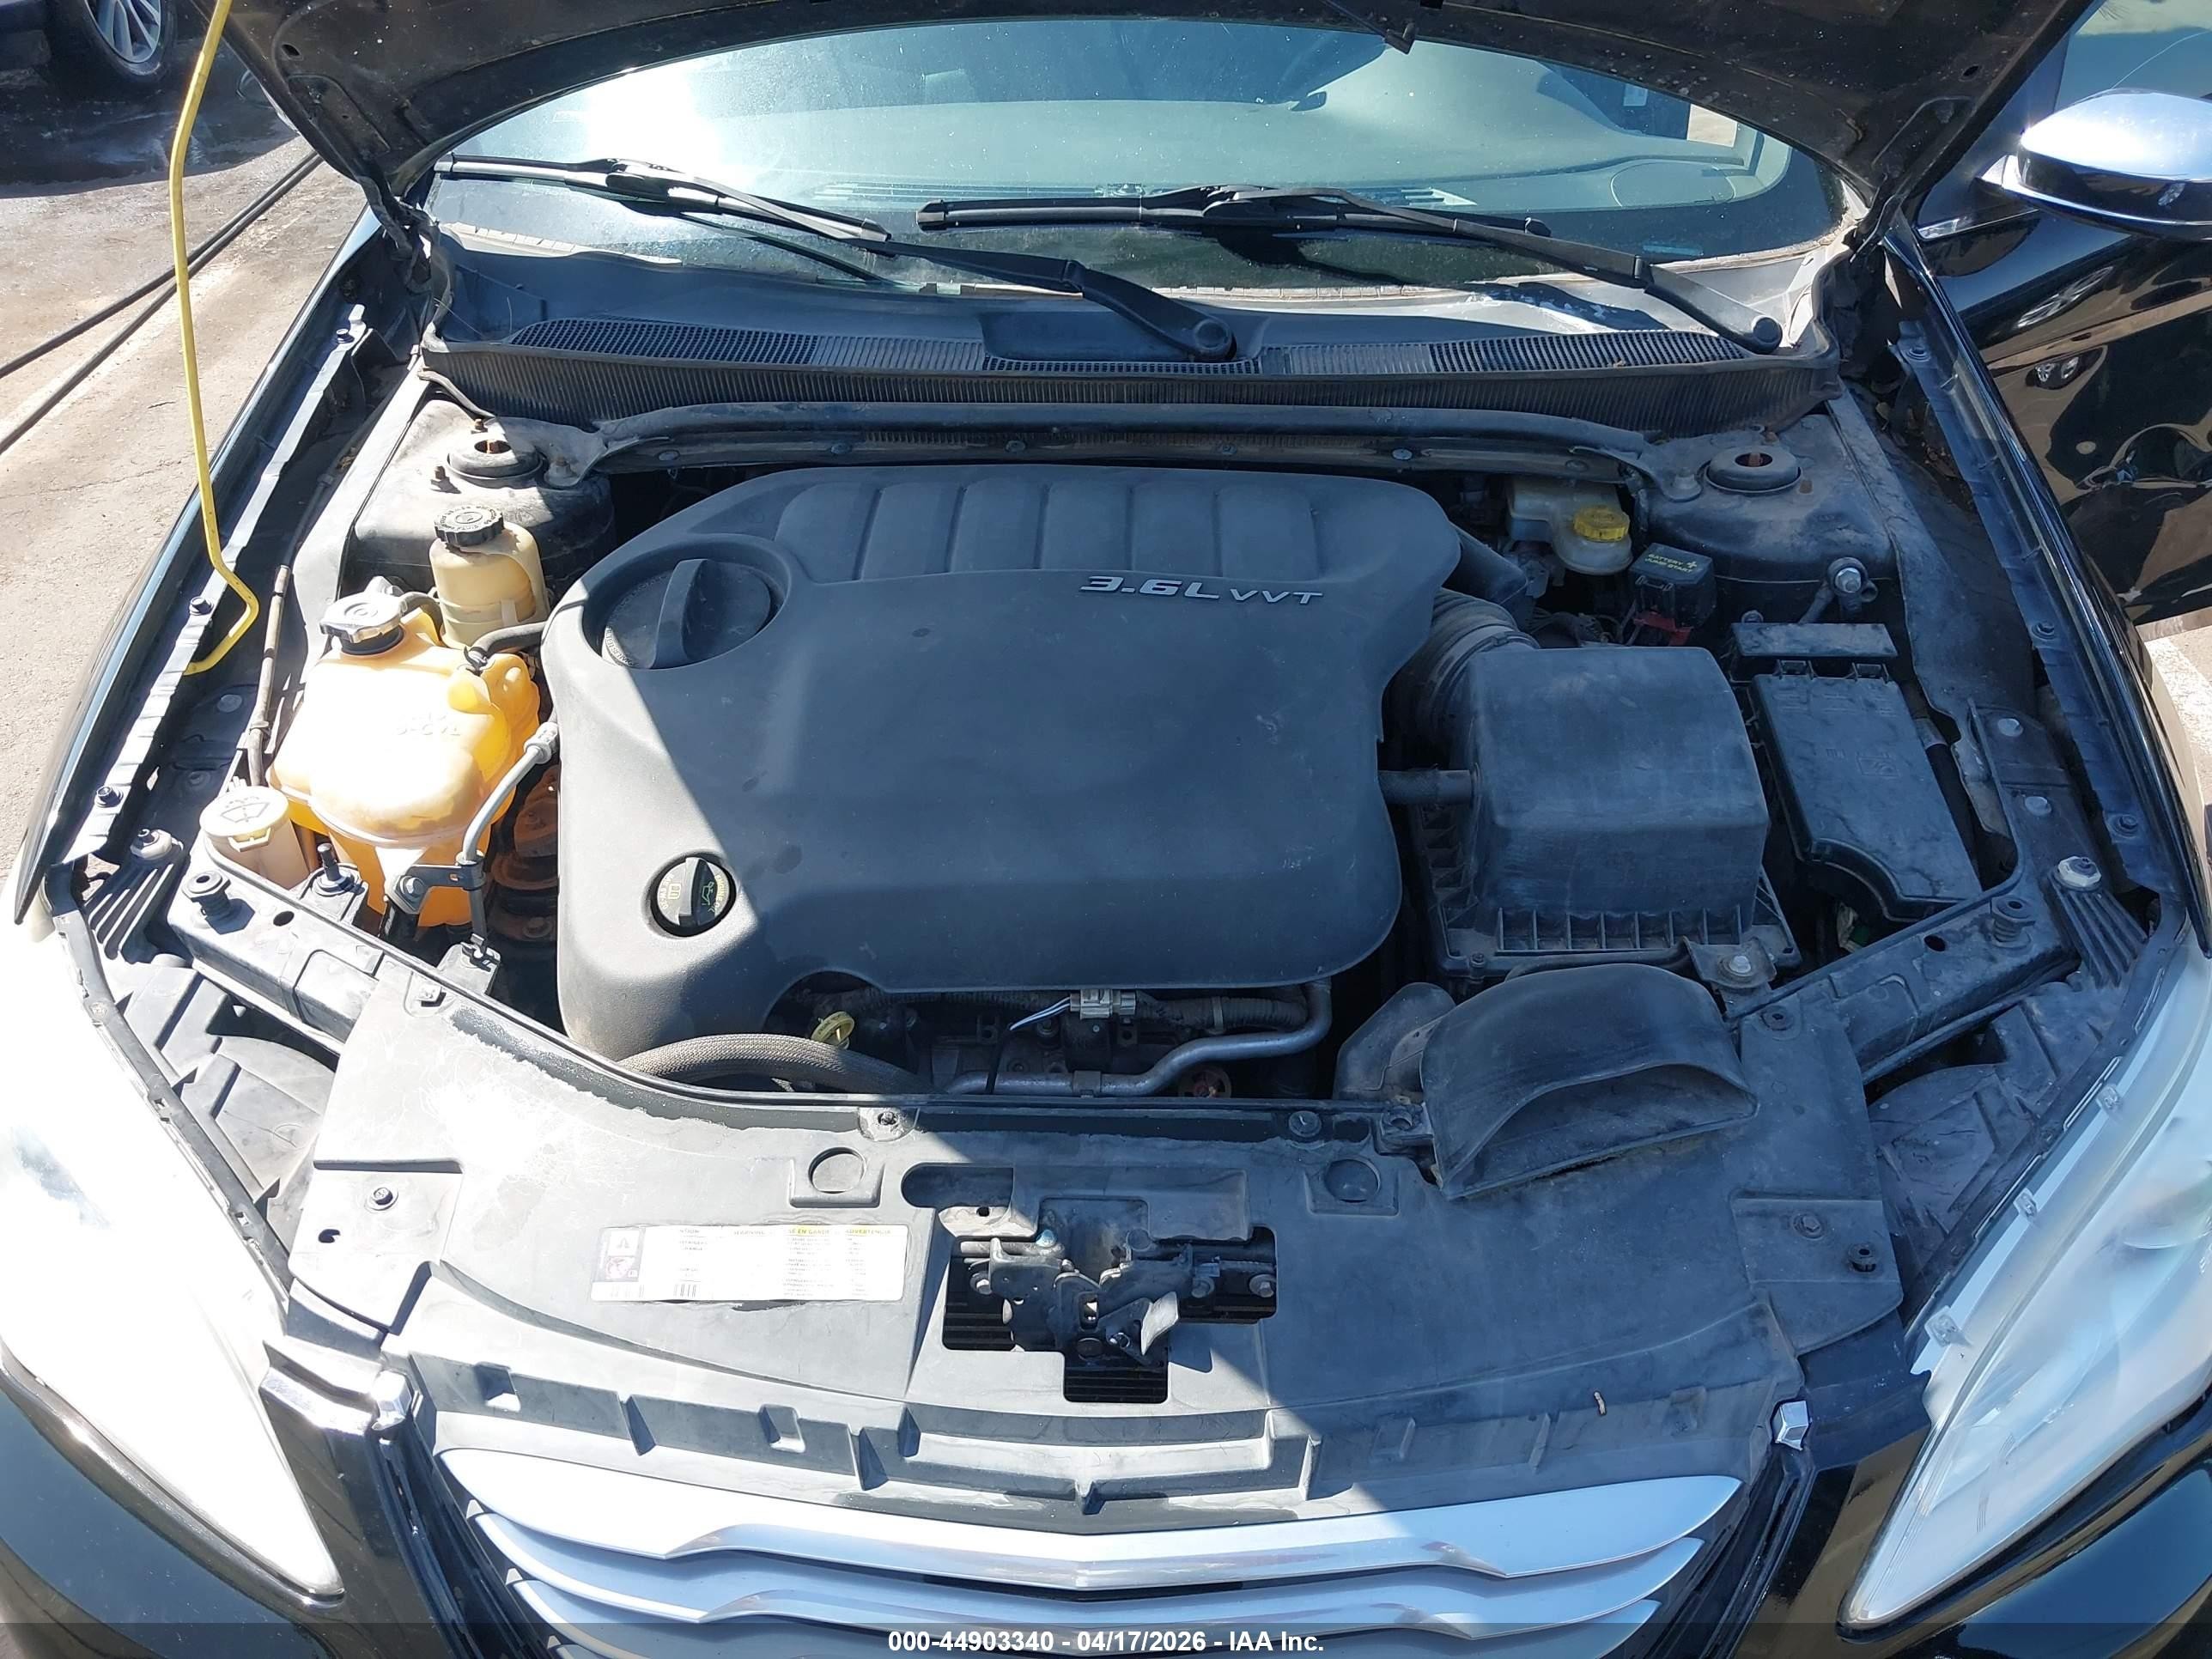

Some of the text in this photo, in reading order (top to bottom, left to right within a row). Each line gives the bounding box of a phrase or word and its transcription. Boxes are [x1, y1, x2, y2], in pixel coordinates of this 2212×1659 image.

[1648, 554, 1684, 565] BATTERY
[1668, 563, 1693, 573] START
[1079, 575, 1323, 605] 3.6L VVT
[714, 874, 726, 902] ENGINE
